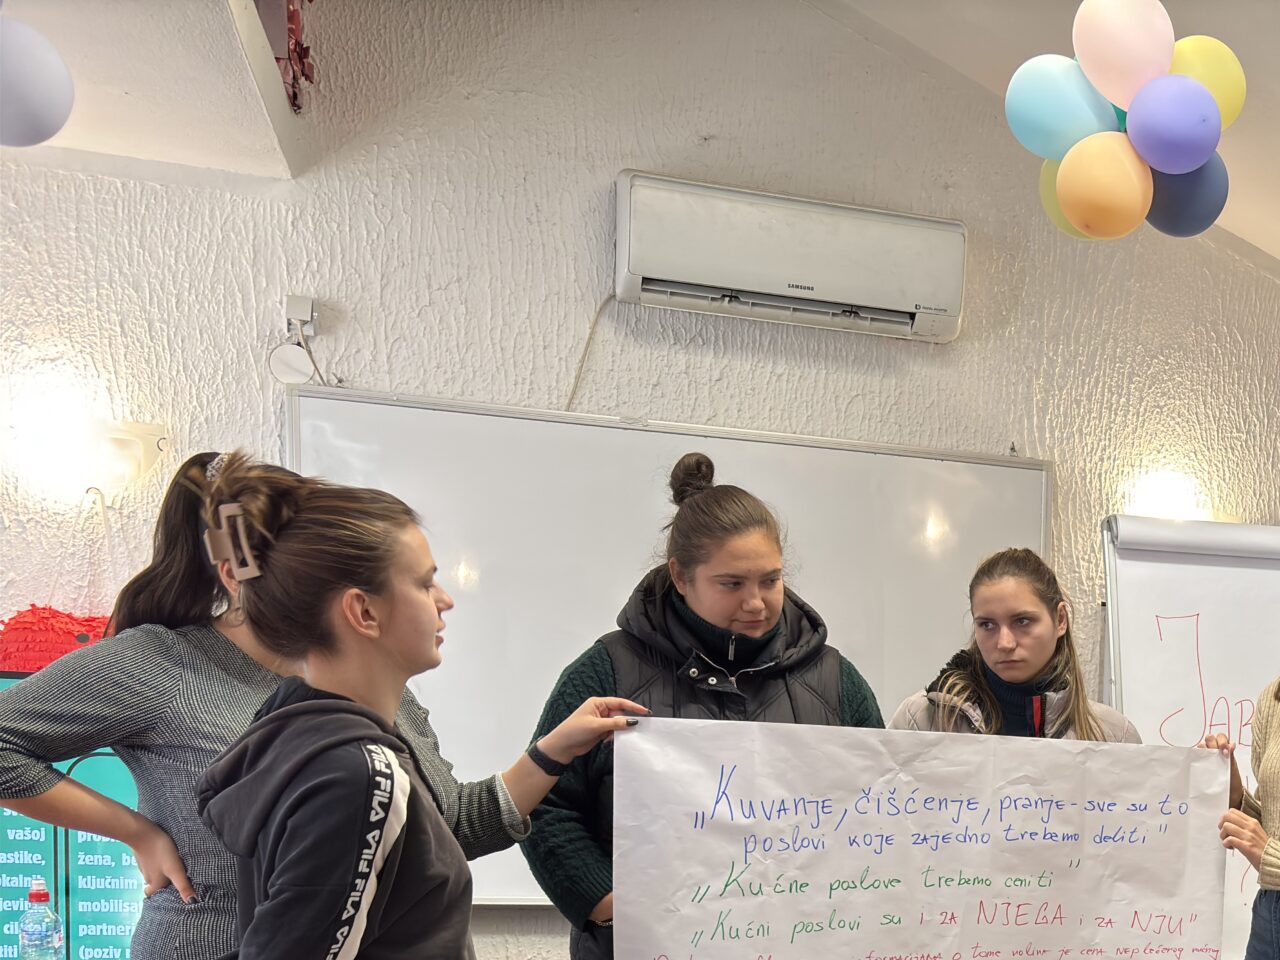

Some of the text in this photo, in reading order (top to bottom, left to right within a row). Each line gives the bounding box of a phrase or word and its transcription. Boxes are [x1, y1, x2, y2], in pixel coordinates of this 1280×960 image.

[787, 283, 815, 291] SAMSUNG
[369, 776, 392, 822] FILA
[1083, 799, 1121, 812] sve
[1126, 800, 1148, 812] su
[1157, 794, 1189, 816] to
[7, 827, 46, 842] vašoj
[744, 825, 826, 864] poslovi
[77, 851, 116, 868] žena,
[358, 829, 380, 873] FILA
[78, 875, 138, 890] ključnim
[829, 866, 902, 899] poslove
[341, 878, 366, 921] FILA
[791, 909, 863, 944] poslovi
[880, 914, 902, 925] su
[976, 897, 1069, 928] NJEGA
[78, 945, 122, 960] (poziv
[970, 942, 1001, 959] tome
